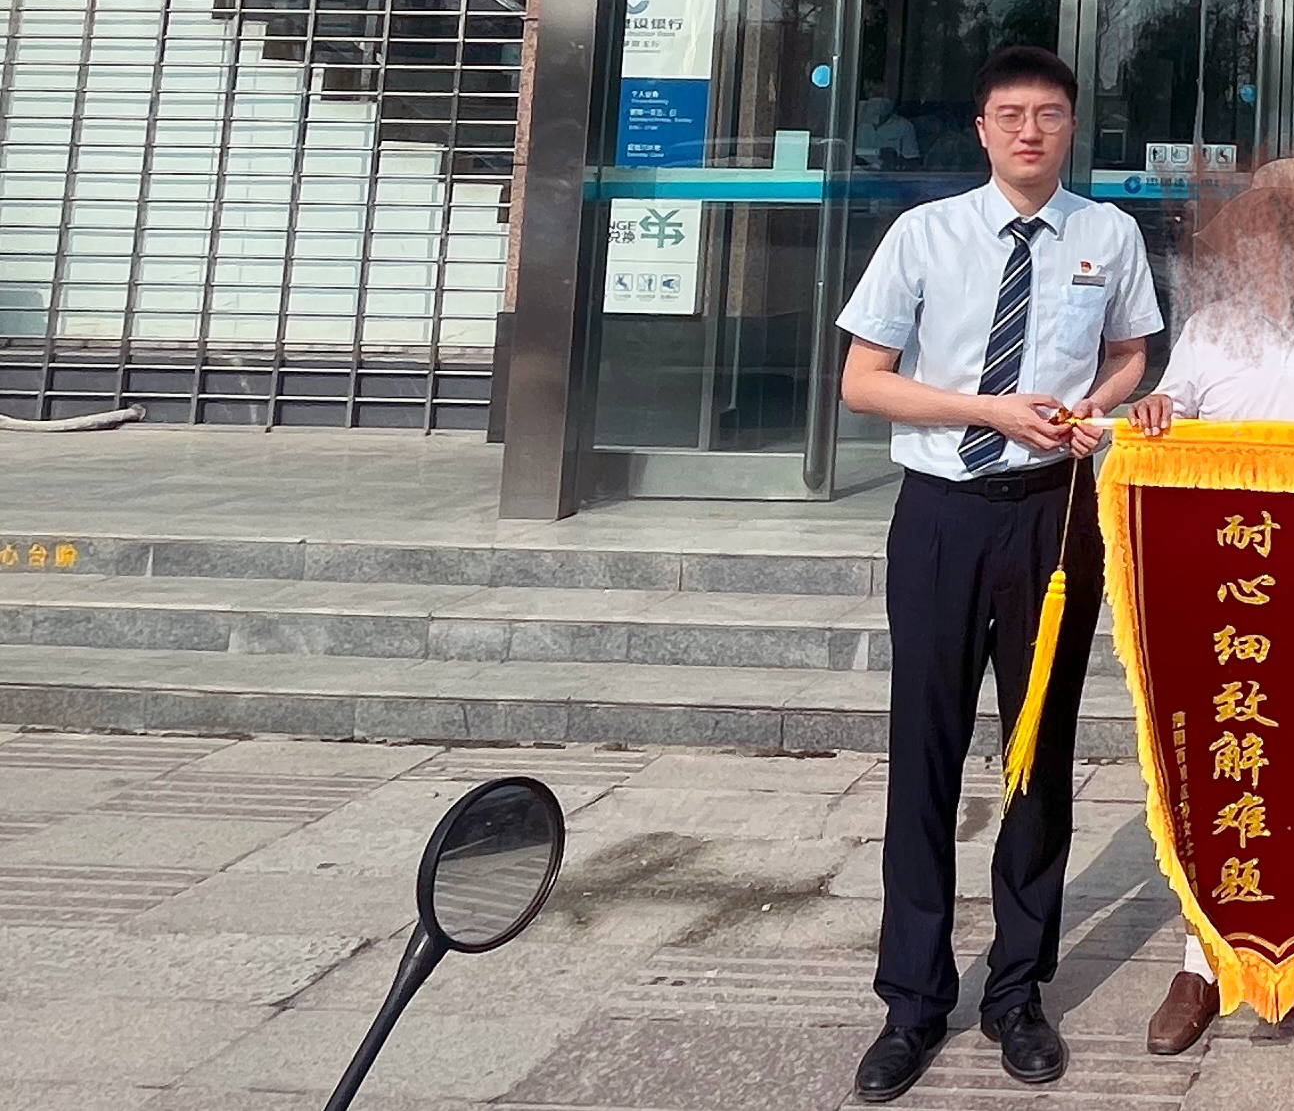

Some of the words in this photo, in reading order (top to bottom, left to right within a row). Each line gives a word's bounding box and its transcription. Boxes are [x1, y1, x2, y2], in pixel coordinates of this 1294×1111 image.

[1209, 510, 1281, 906] 耐心细致解难题
